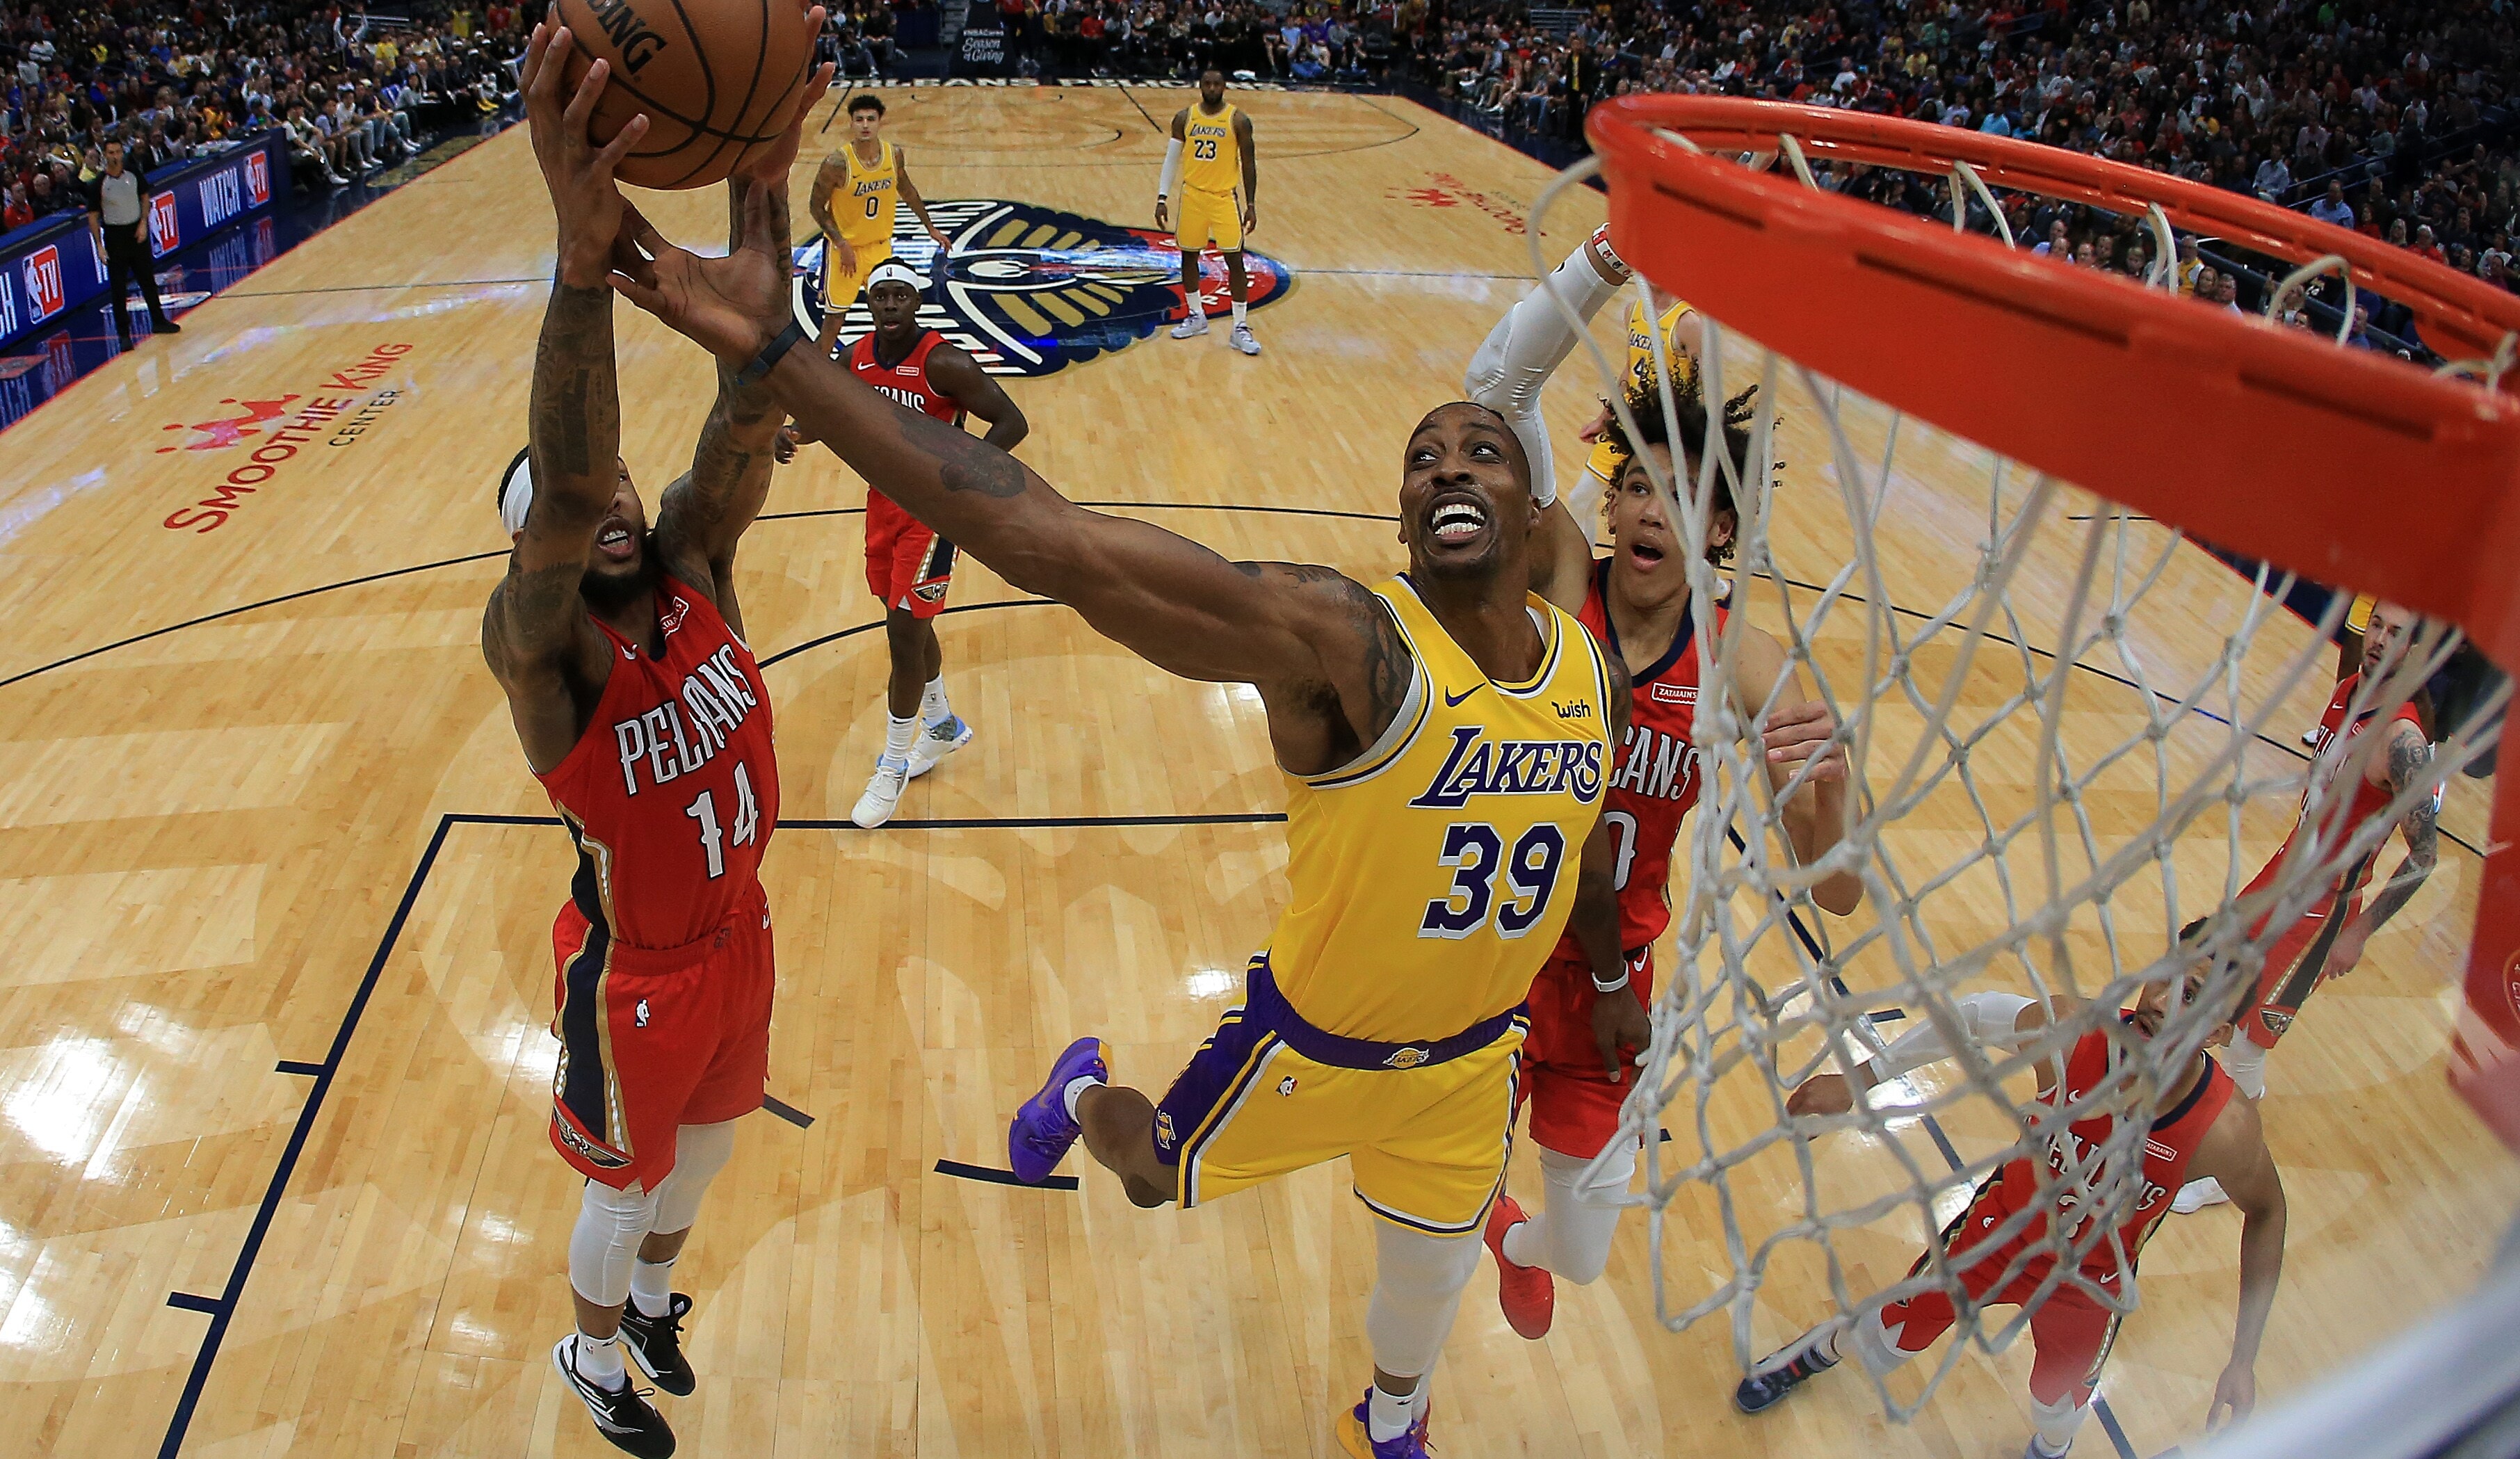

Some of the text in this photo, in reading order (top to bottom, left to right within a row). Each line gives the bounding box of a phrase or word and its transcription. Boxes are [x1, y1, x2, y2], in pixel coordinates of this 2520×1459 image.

[1058, 78, 1286, 92] PELICNS
[1194, 139, 1217, 161] 23
[159, 202, 175, 241] TV
[199, 166, 241, 228] WATCH
[865, 196, 879, 220] 0
[38, 258, 58, 303] TV
[328, 389, 405, 448] CENTER
[163, 397, 354, 534] SMOOTHIE
[1551, 698, 1592, 719] wish
[1405, 725, 1604, 809] LAKERS
[686, 761, 759, 878] 14
[1416, 821, 1567, 940] 39
